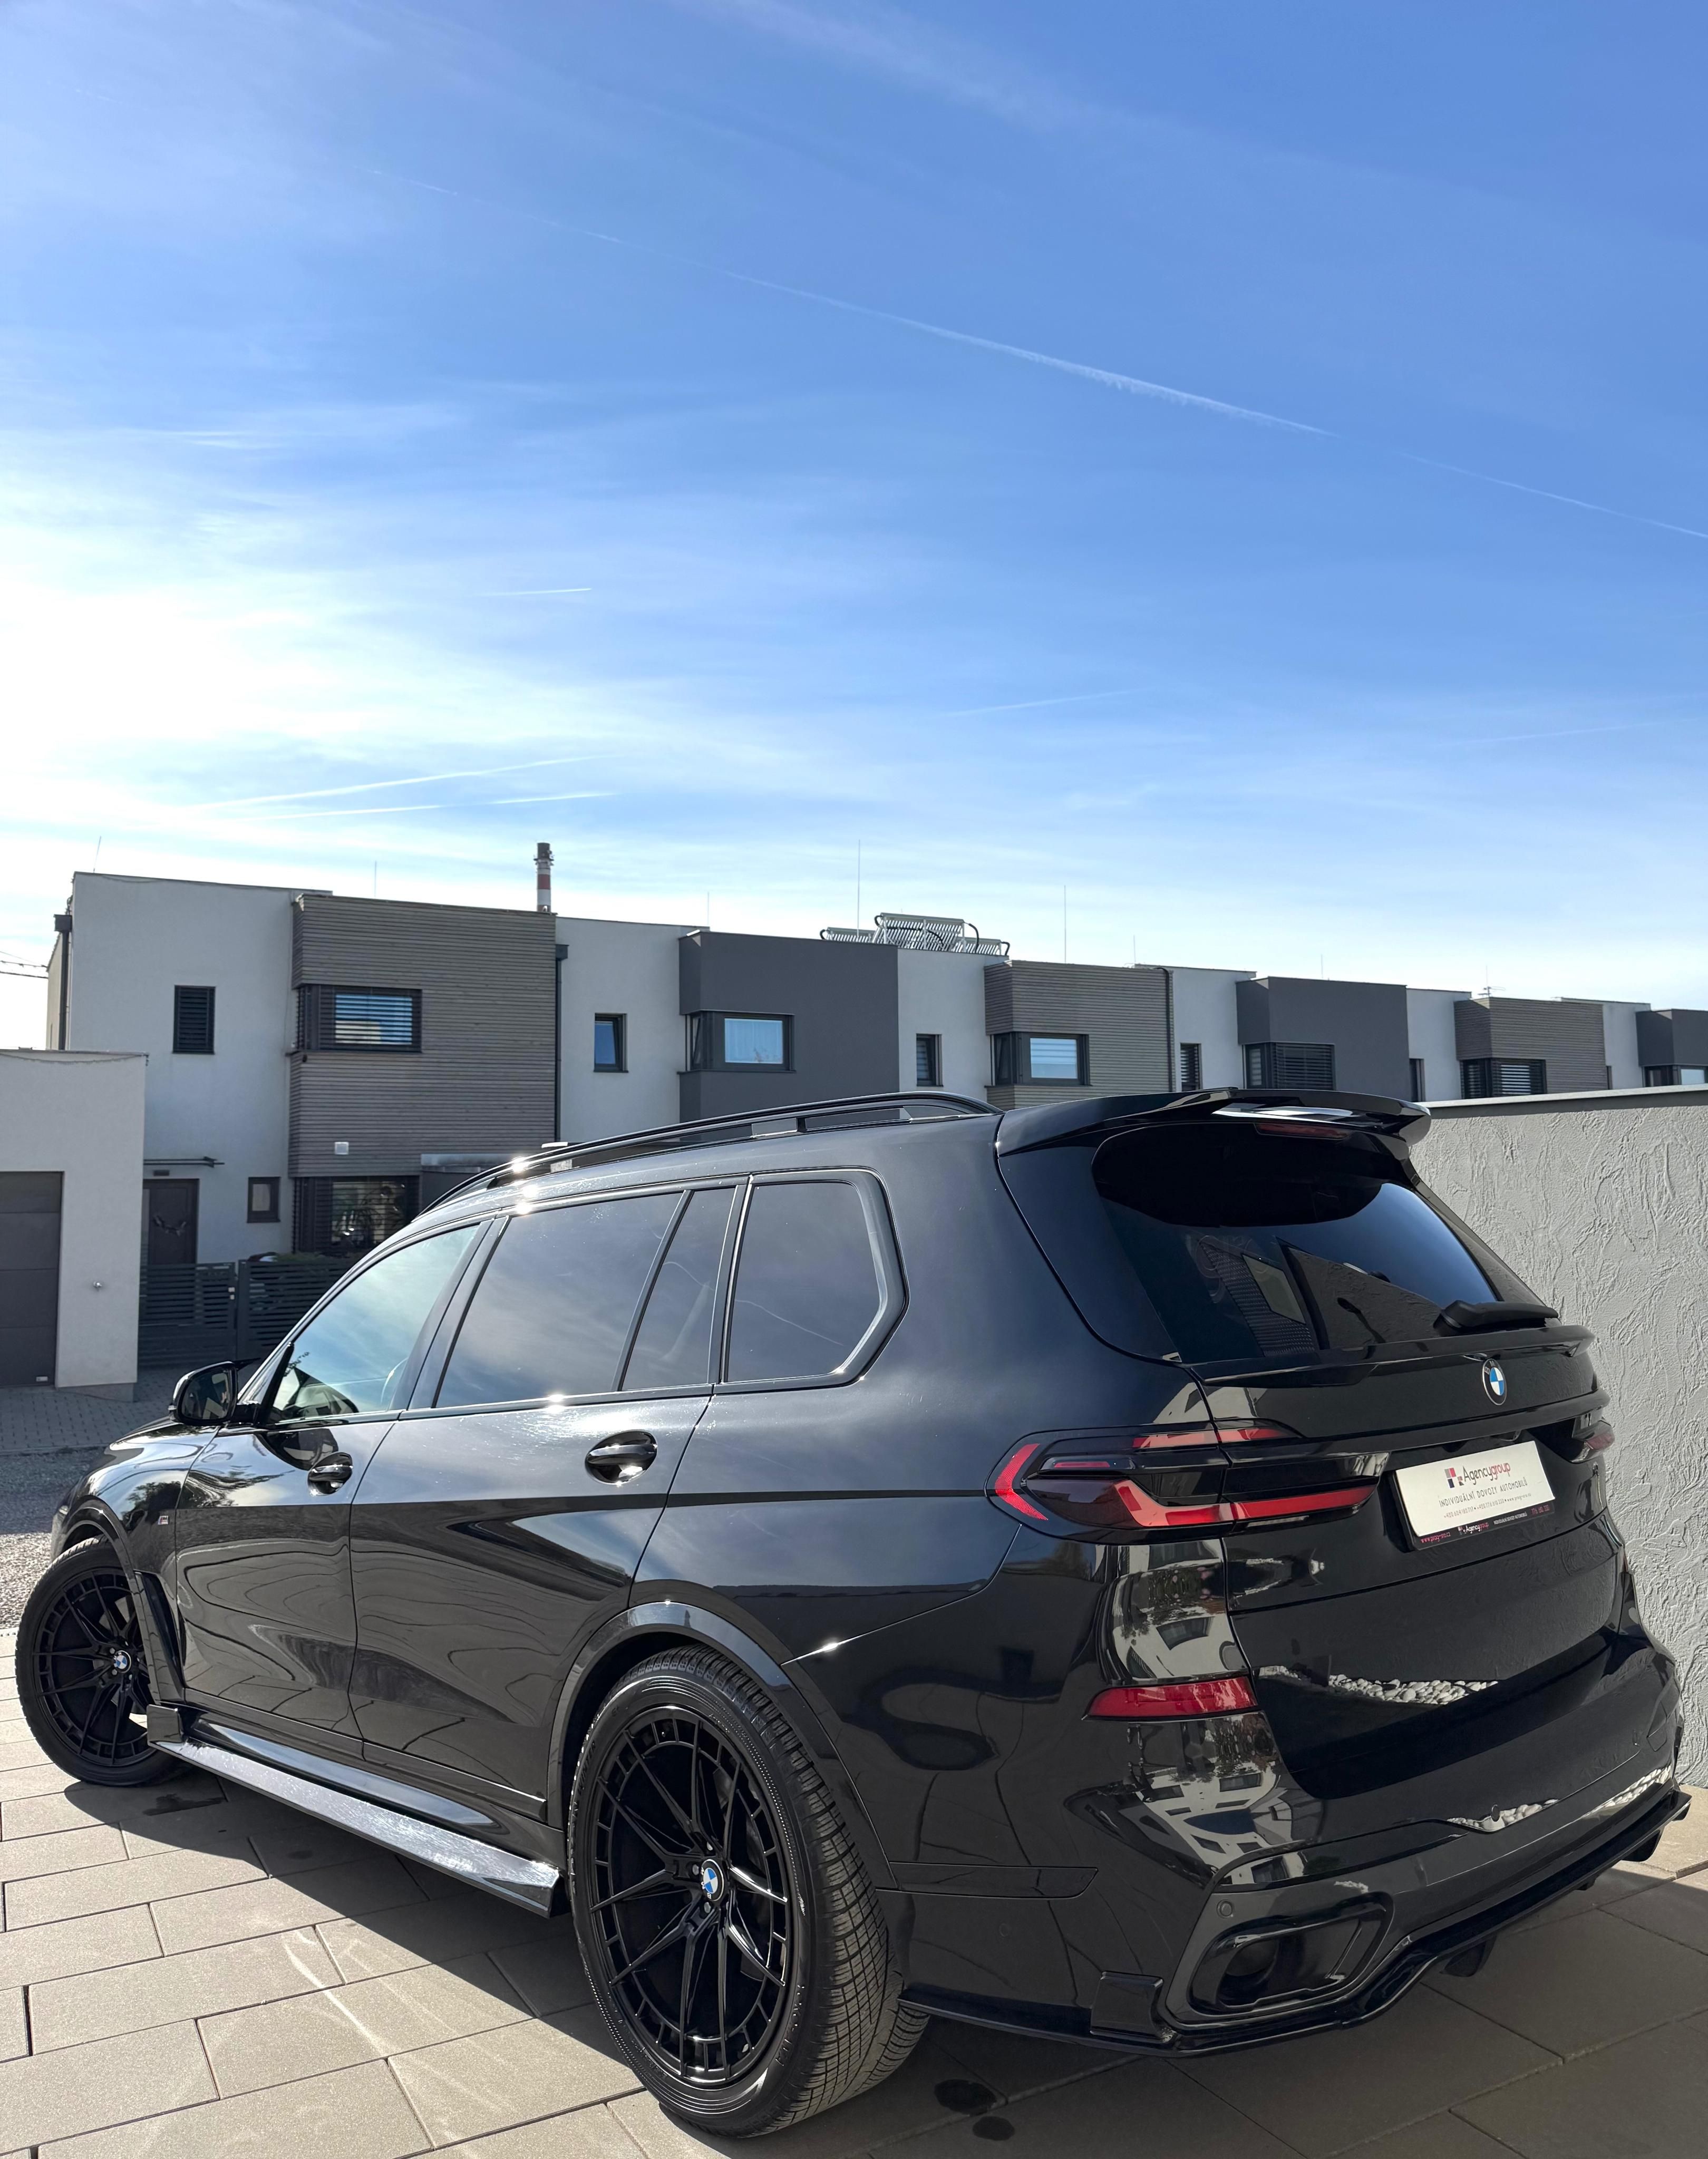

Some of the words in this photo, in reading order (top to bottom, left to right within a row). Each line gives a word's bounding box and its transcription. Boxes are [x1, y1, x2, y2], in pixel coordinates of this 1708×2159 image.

[1463, 1463, 1511, 1485] Agencygroup
[1439, 1491, 1475, 1508] INDIVIDUÁLNÍ
[1477, 1486, 1498, 1498] DOVOZY
[1500, 1476, 1528, 1492] AUTOMOBILŮ
